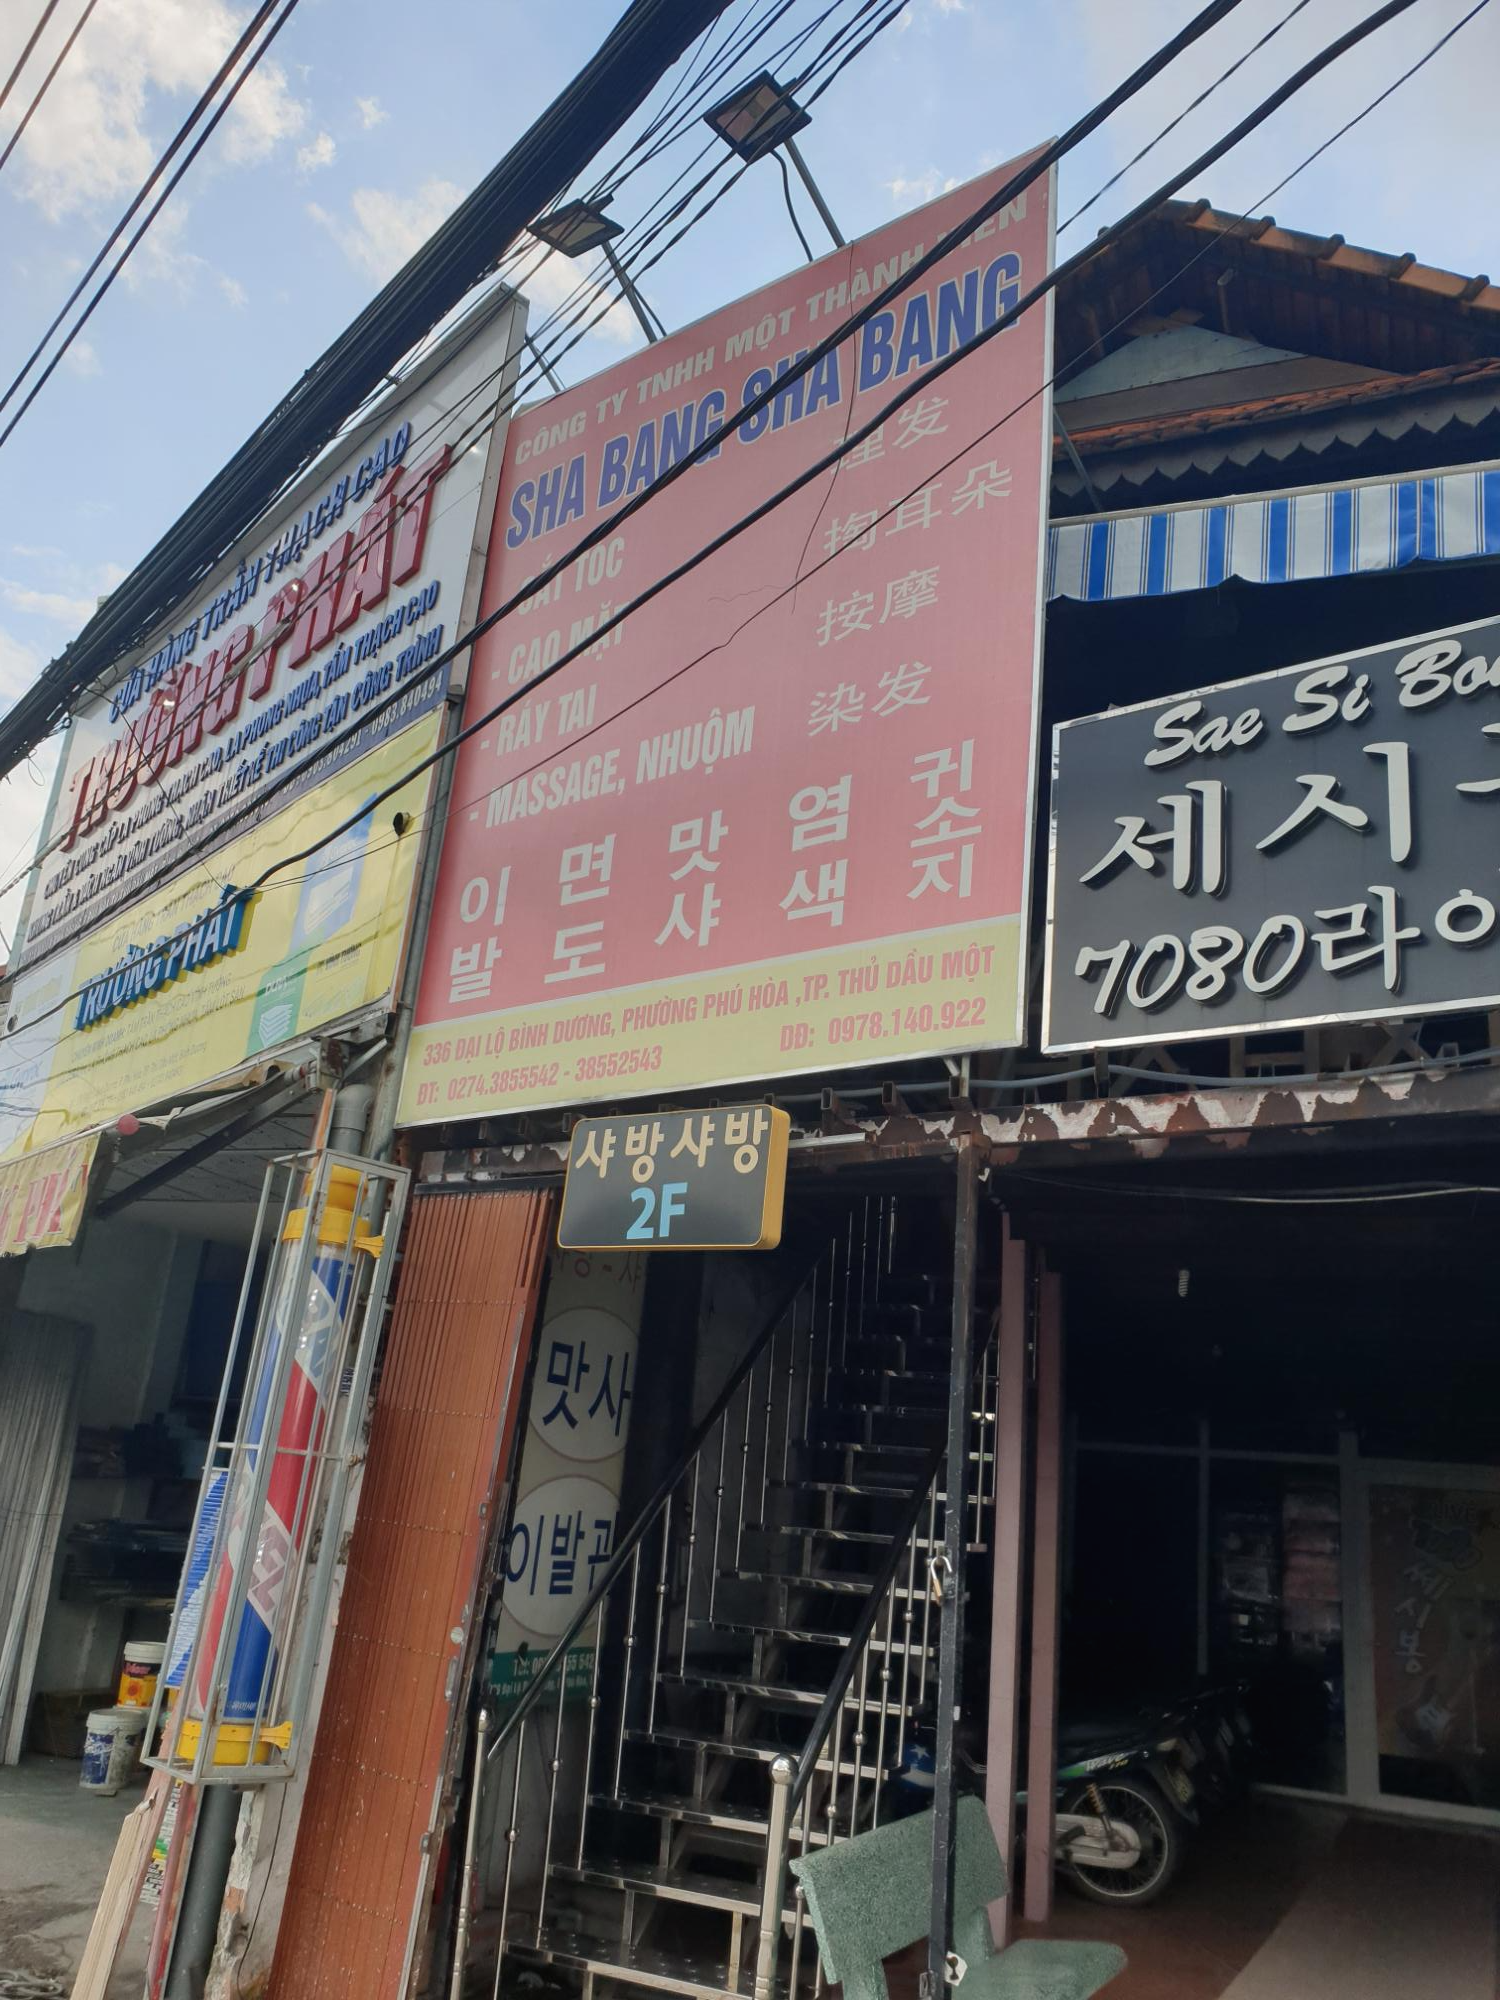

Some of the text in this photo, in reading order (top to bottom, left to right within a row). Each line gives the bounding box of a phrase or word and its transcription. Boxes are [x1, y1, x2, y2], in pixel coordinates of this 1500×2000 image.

[506, 251, 1022, 550] SHA BANG SHA BANG
[515, 410, 587, 465] CÔNG
[597, 388, 628, 424] TY
[637, 346, 716, 399] TNHH
[725, 306, 796, 362] MỘT
[143, 614, 200, 695] HÀNG
[199, 553, 264, 644] TRẦN
[264, 473, 351, 584] THẠCH
[350, 418, 412, 504] CAO
[823, 460, 1012, 555] 掏耳朵
[257, 442, 448, 698] PHÁT
[816, 565, 941, 647] 按摩
[321, 642, 352, 691] TẤM
[352, 602, 406, 667] THẠCH
[405, 575, 439, 628] CAO
[507, 629, 562, 687] CAO
[265, 735, 286, 774] THI
[288, 712, 321, 757] CÔNG
[351, 659, 392, 712] CÔNG
[394, 621, 443, 683] TRÌNH
[371, 668, 443, 735] 0983.840494
[496, 699, 551, 756] RÁY
[557, 684, 597, 736] TAI
[808, 661, 932, 738] 染发
[1144, 700, 1264, 767] Sae
[1282, 665, 1373, 734] Si
[485, 749, 625, 828] MASSAGE,
[635, 705, 755, 785] NHUỘM
[544, 833, 617, 984] 면도
[655, 809, 729, 947] 맛샤
[779, 774, 853, 927] 염색
[448, 866, 512, 1003] 이발
[423, 1041, 451, 1067] 336
[455, 1034, 483, 1064] ĐẠI
[485, 1026, 505, 1060] LỘ
[508, 1023, 549, 1052] BÌNH
[553, 1011, 616, 1045] DƯƠNG,
[622, 995, 698, 1033] PHƯỜNG
[702, 983, 743, 1019] PHÚ
[748, 976, 789, 1013] HÒA
[838, 955, 880, 997] THỦ
[886, 948, 935, 989] DẦU
[940, 942, 996, 983] MỘT
[828, 997, 987, 1045] 0978.140.922
[446, 1062, 559, 1101] 0274.3855542
[575, 1045, 663, 1082] 38552543
[575, 1108, 768, 1183] 샤방샤방
[626, 1182, 689, 1239] 2F
